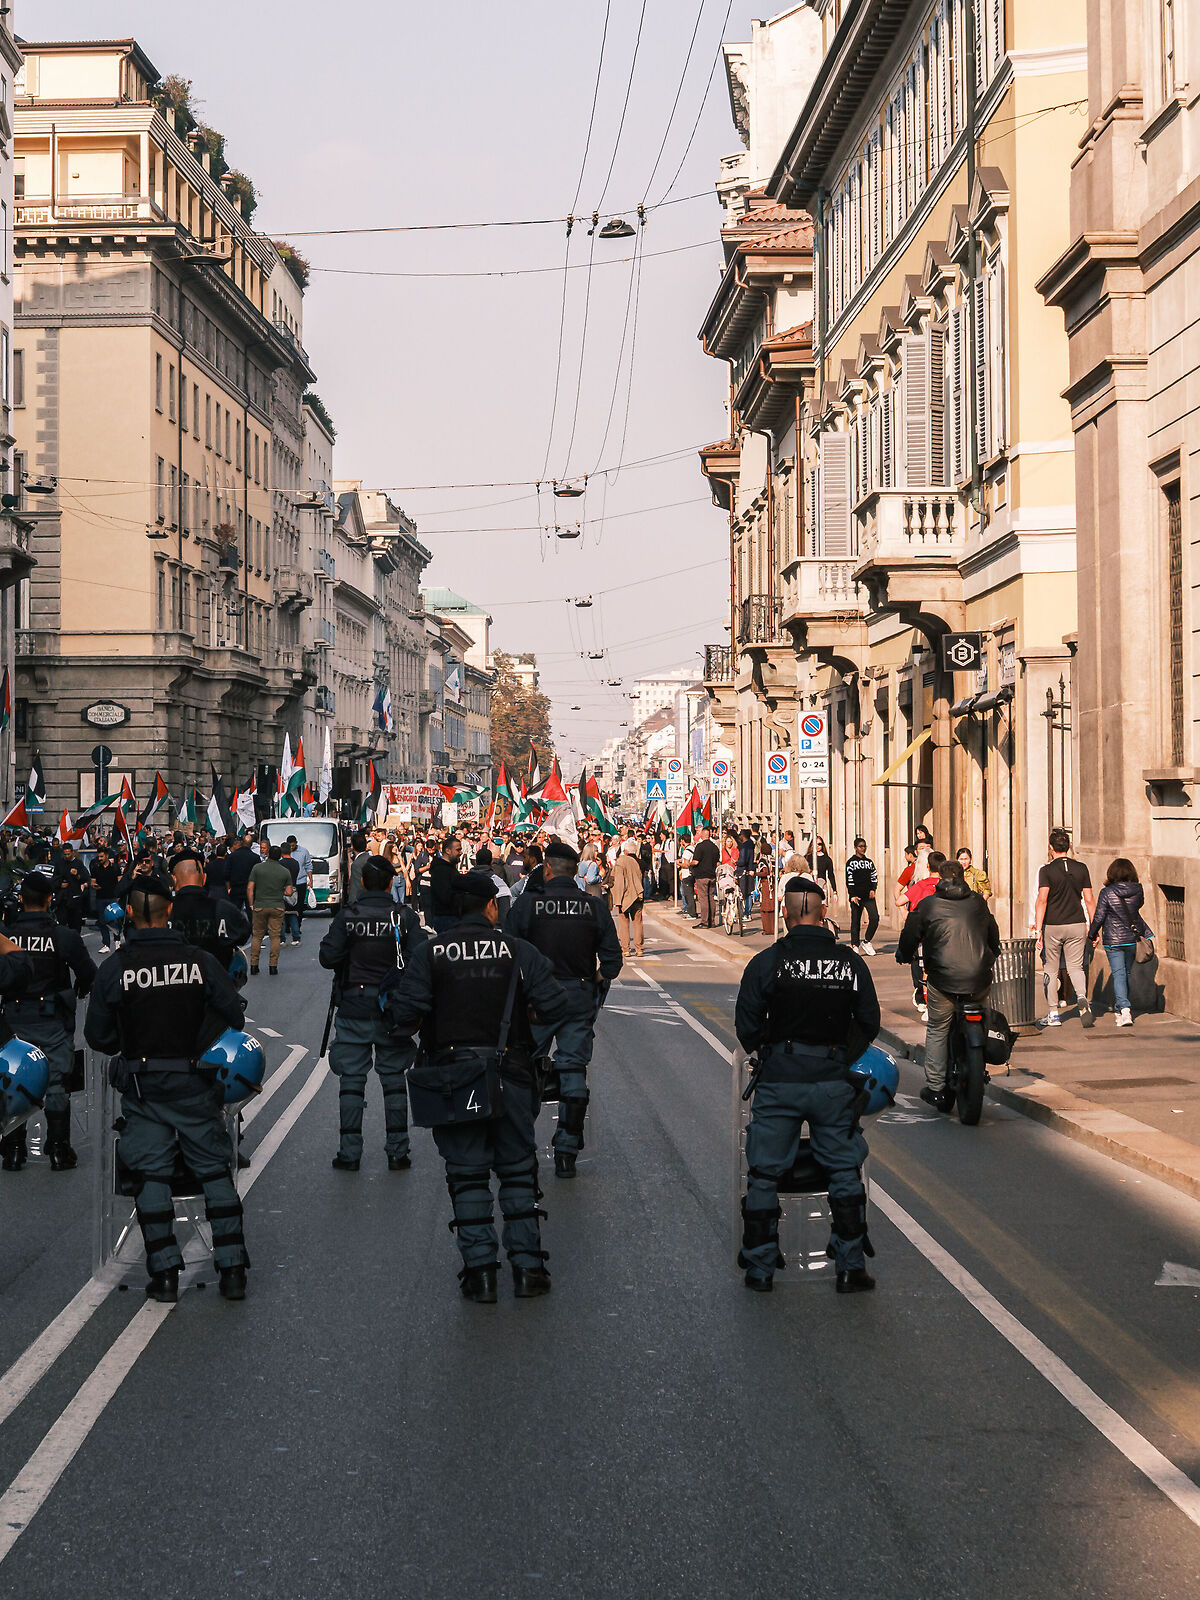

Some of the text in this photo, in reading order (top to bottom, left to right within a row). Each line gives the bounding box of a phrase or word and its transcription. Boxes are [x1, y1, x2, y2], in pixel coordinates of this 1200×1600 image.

[958, 647, 968, 660] B
[535, 900, 593, 916] POLIZIA
[346, 921, 407, 937] POLIZI
[8, 935, 55, 952] OLIZIA
[433, 940, 512, 961] POLIZIA
[122, 963, 204, 990] POLIZIA
[466, 1089, 482, 1112] 4
